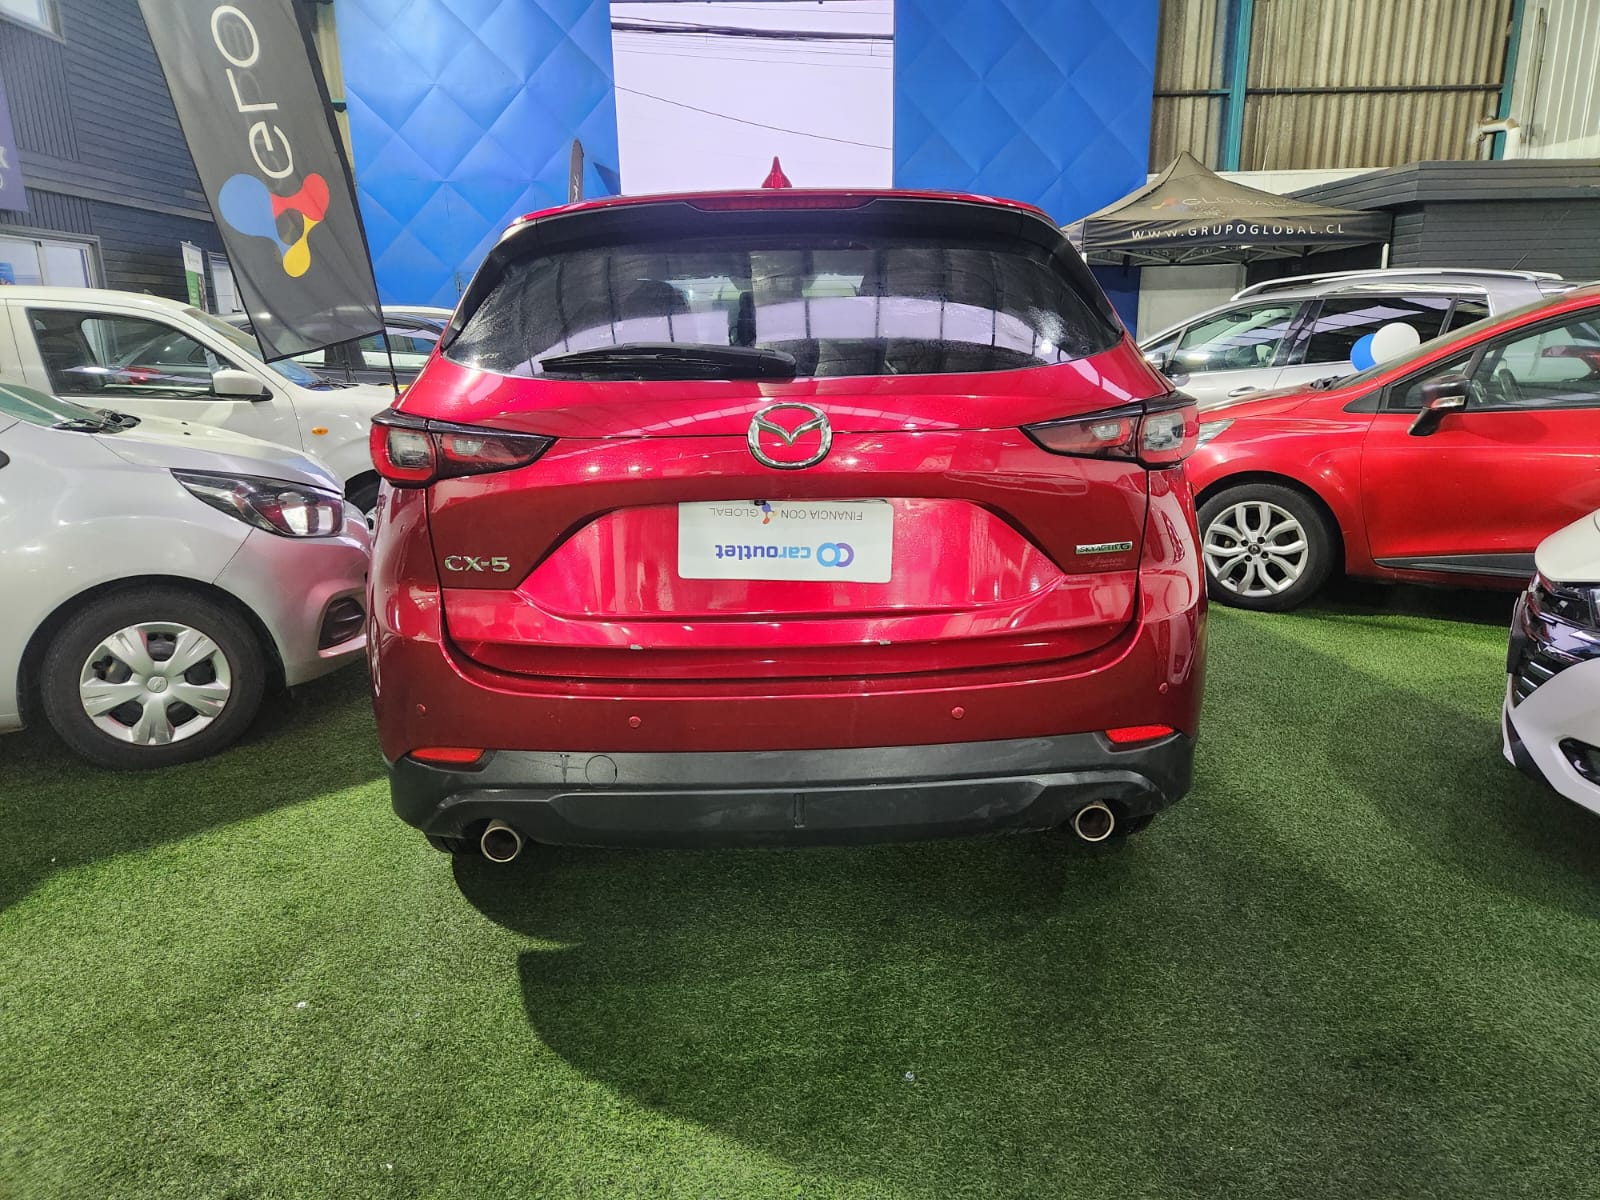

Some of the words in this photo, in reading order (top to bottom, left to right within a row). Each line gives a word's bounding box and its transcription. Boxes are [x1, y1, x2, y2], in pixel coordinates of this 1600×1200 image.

[1131, 223, 1345, 240] WWW.GRUPOGLOBAL.CL
[710, 507, 759, 518] GLOBAL
[781, 508, 807, 520] CON
[809, 509, 863, 521] FINANCIA
[715, 545, 811, 560] caroutlet
[444, 555, 511, 572] CX-5
